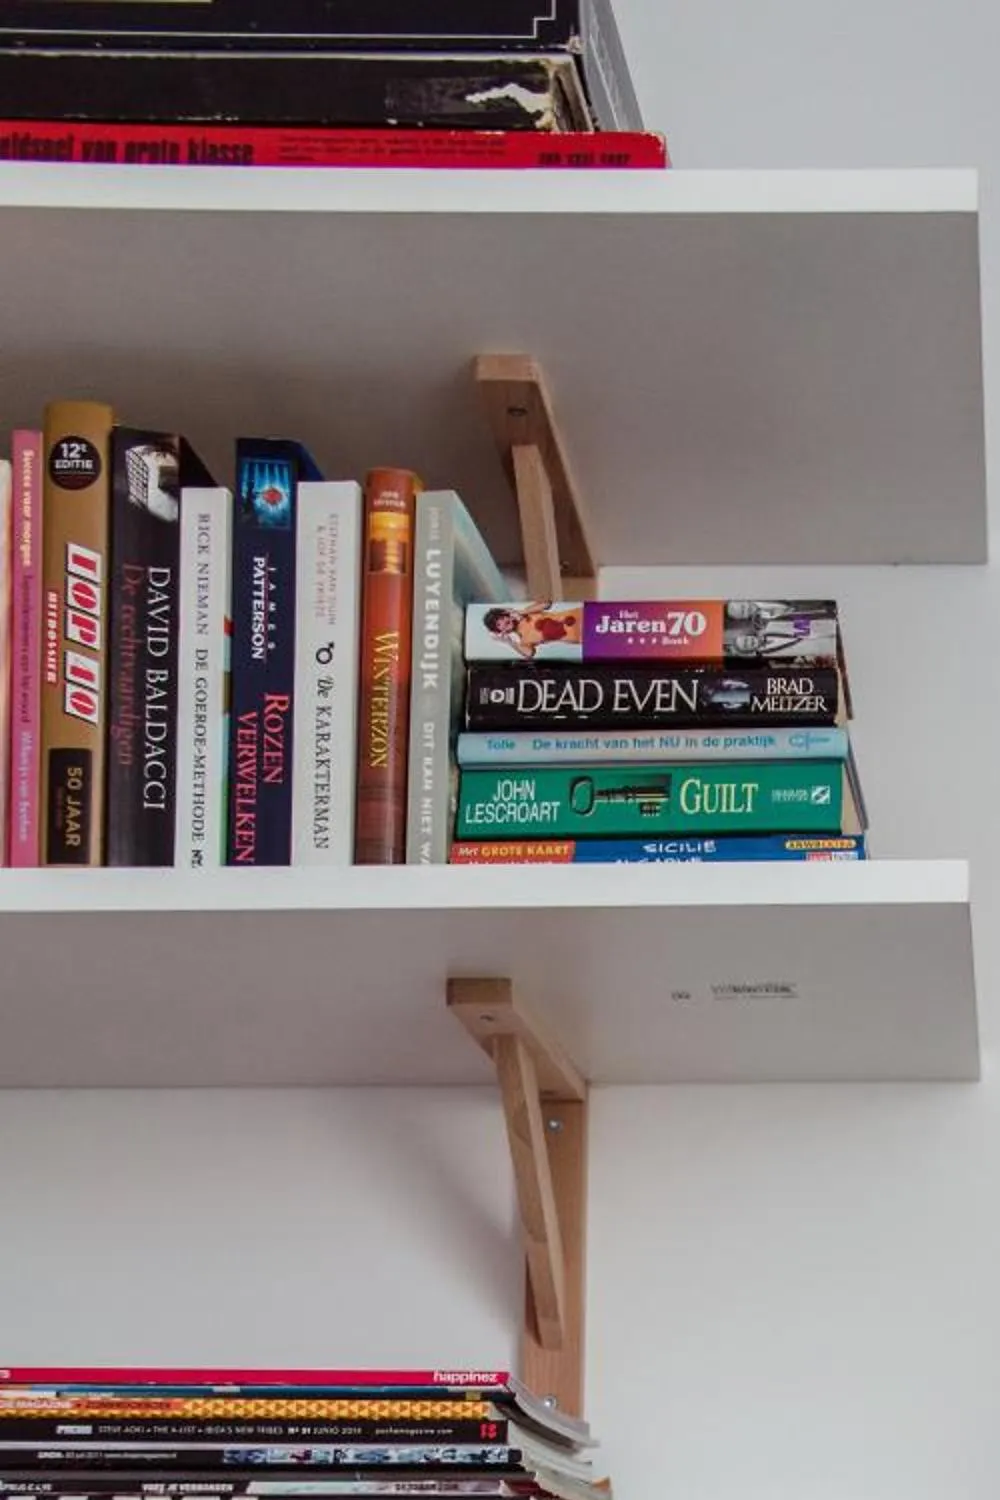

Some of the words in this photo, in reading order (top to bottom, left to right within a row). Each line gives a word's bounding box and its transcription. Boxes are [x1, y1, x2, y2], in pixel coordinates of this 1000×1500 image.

[55, 459, 93, 469] EDITIE
[198, 513, 211, 555] RICK
[69, 549, 99, 647] TOP
[121, 564, 145, 597] De
[146, 567, 171, 657] DAVID
[197, 563, 210, 636] NIEMAN
[251, 556, 265, 659] PATTERSON
[267, 567, 277, 649] JAMES
[421, 548, 441, 690] LUYENDIJK
[595, 615, 667, 633] Jaren
[668, 611, 706, 636] 70
[195, 648, 209, 671] DE
[69, 658, 98, 720] 10
[317, 676, 335, 698] De
[370, 631, 399, 768] WINTERZON
[517, 679, 604, 712] DEAD
[613, 679, 699, 712] EVEN
[751, 695, 828, 712] MELTZER
[767, 677, 814, 695] BRAD
[143, 669, 168, 811] BALDACCI
[263, 692, 290, 785] ROZEN
[423, 722, 435, 748] DIT
[487, 739, 515, 750] Tolle
[532, 739, 551, 750] De
[555, 738, 598, 750] kracht
[604, 739, 629, 749] van
[633, 737, 655, 749] het
[659, 736, 680, 748] NU
[685, 736, 698, 747] in
[702, 735, 720, 747] de
[724, 735, 776, 749] praktijk
[192, 677, 208, 842] GOEROE-METHODE
[313, 706, 332, 849] KARAKTERMAN
[422, 757, 434, 790] KAN
[67, 767, 83, 790] 50
[236, 711, 257, 864] VERWELKEN
[492, 779, 536, 802] JOHN
[679, 778, 759, 815] GUILT
[65, 795, 82, 847] JAAR
[421, 798, 432, 835] NIET
[465, 801, 560, 824] LESCROART
[481, 845, 522, 857] GROTE
[527, 844, 569, 857] KAART
[432, 1371, 498, 1384] happinez
